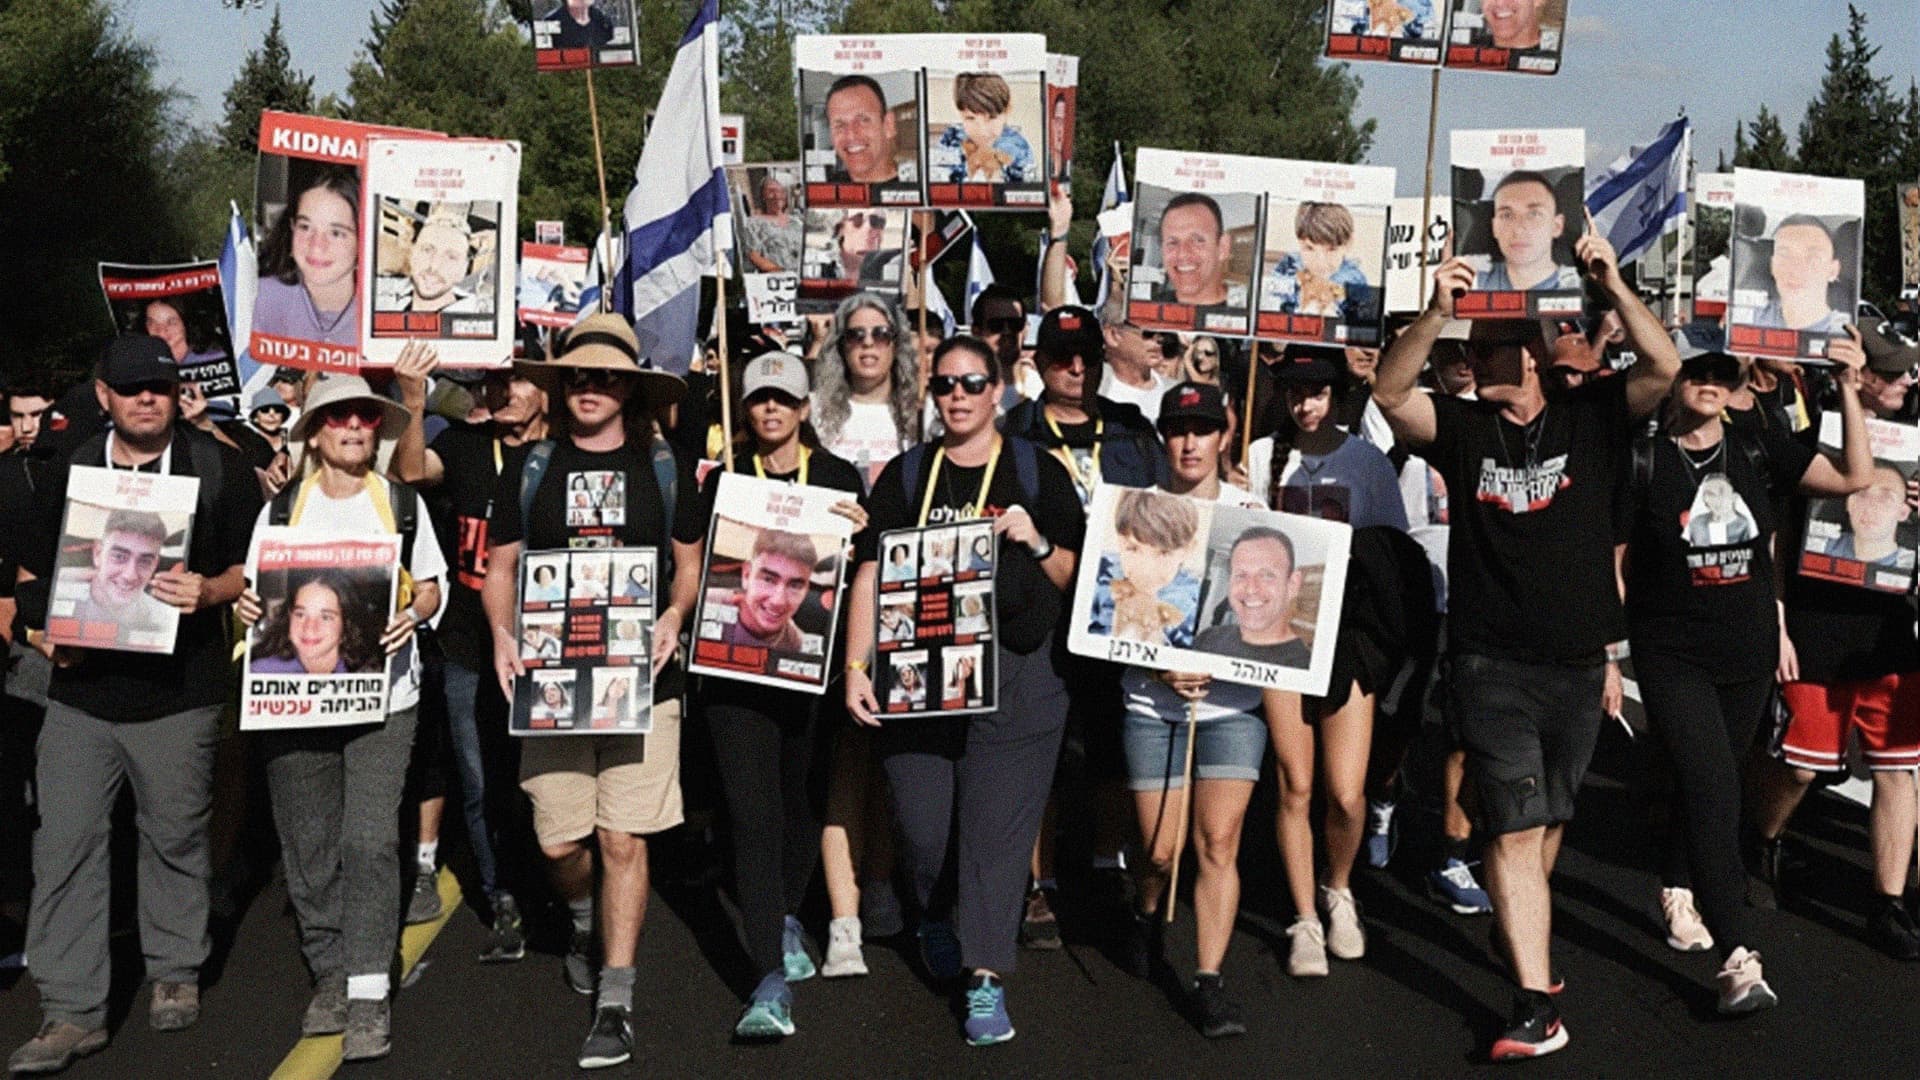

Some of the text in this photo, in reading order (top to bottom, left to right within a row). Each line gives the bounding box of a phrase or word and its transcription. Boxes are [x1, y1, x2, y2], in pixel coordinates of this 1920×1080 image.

[272, 126, 362, 159] KIDNA
[259, 337, 311, 361] בעזה
[1108, 639, 1158, 662] איתן
[250, 680, 300, 696] אותם
[249, 696, 381, 716] הביתה עכשיו!
